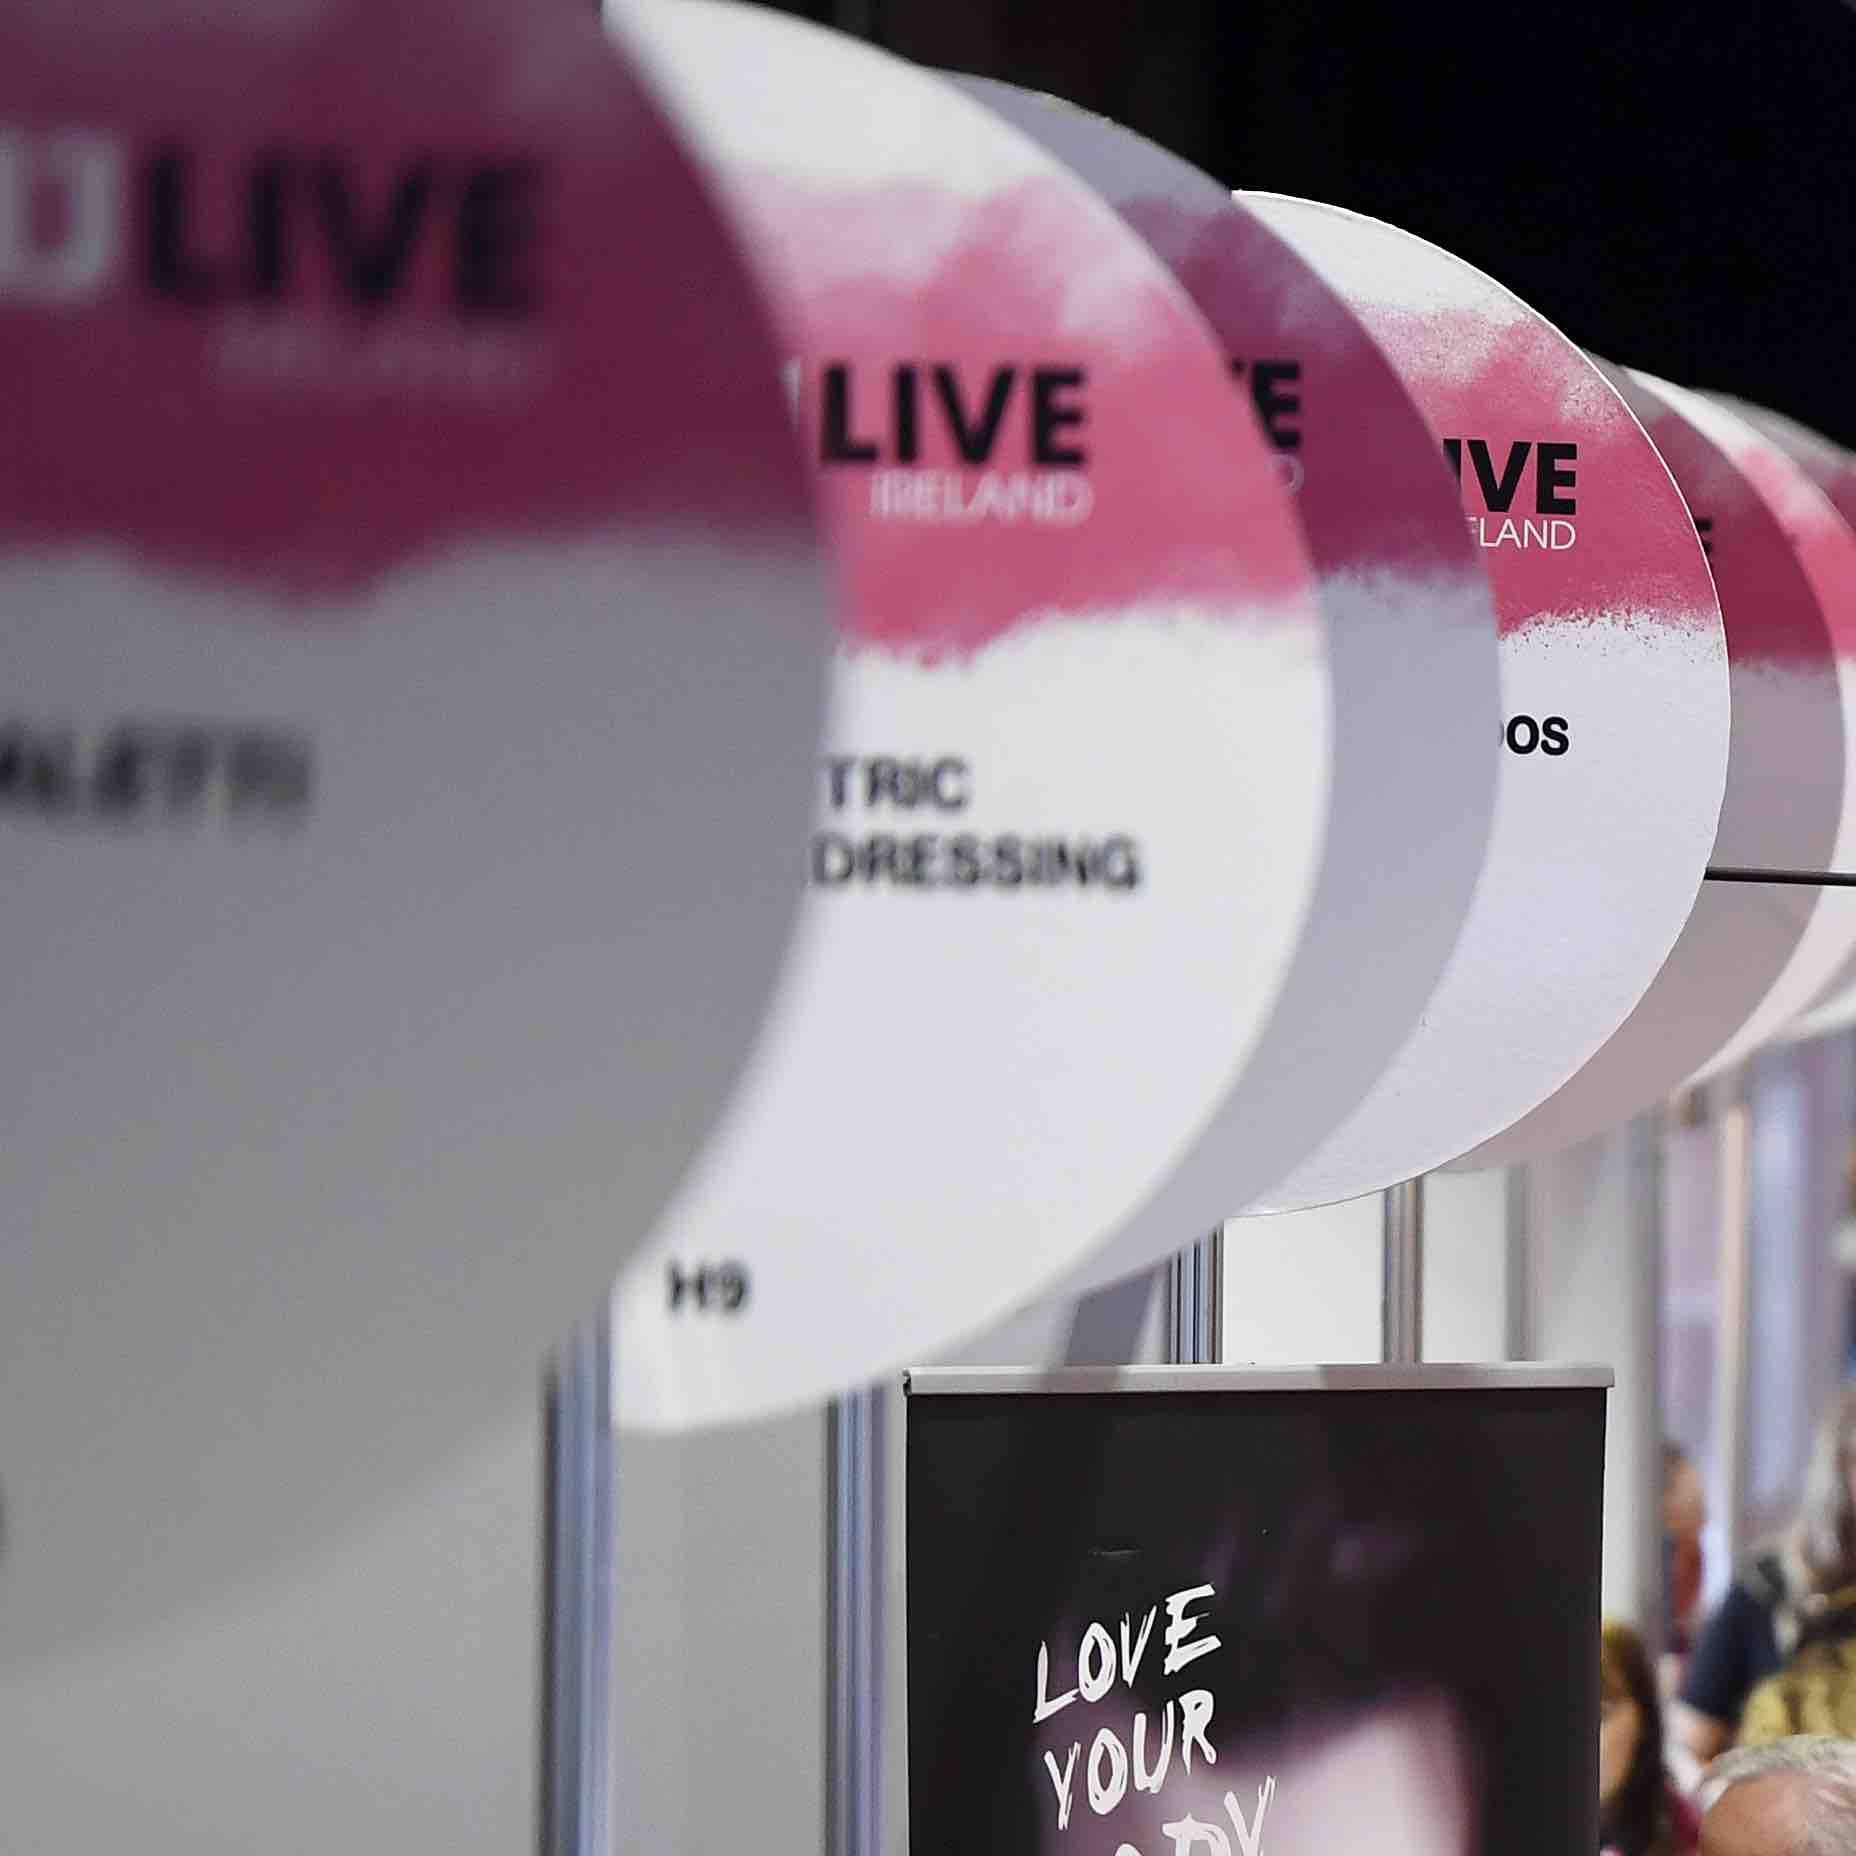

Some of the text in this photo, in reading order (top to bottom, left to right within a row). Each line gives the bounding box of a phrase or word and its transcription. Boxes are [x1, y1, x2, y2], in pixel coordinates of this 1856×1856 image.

[788, 360, 1088, 466] LIVE
[1468, 515, 1577, 550] LAND
[1497, 715, 1570, 756] OS
[810, 832, 1146, 890] DRESSING
[665, 1258, 750, 1314] H9
[1033, 1584, 1222, 1724] LOVE
[1044, 1689, 1217, 1830] YOUR
